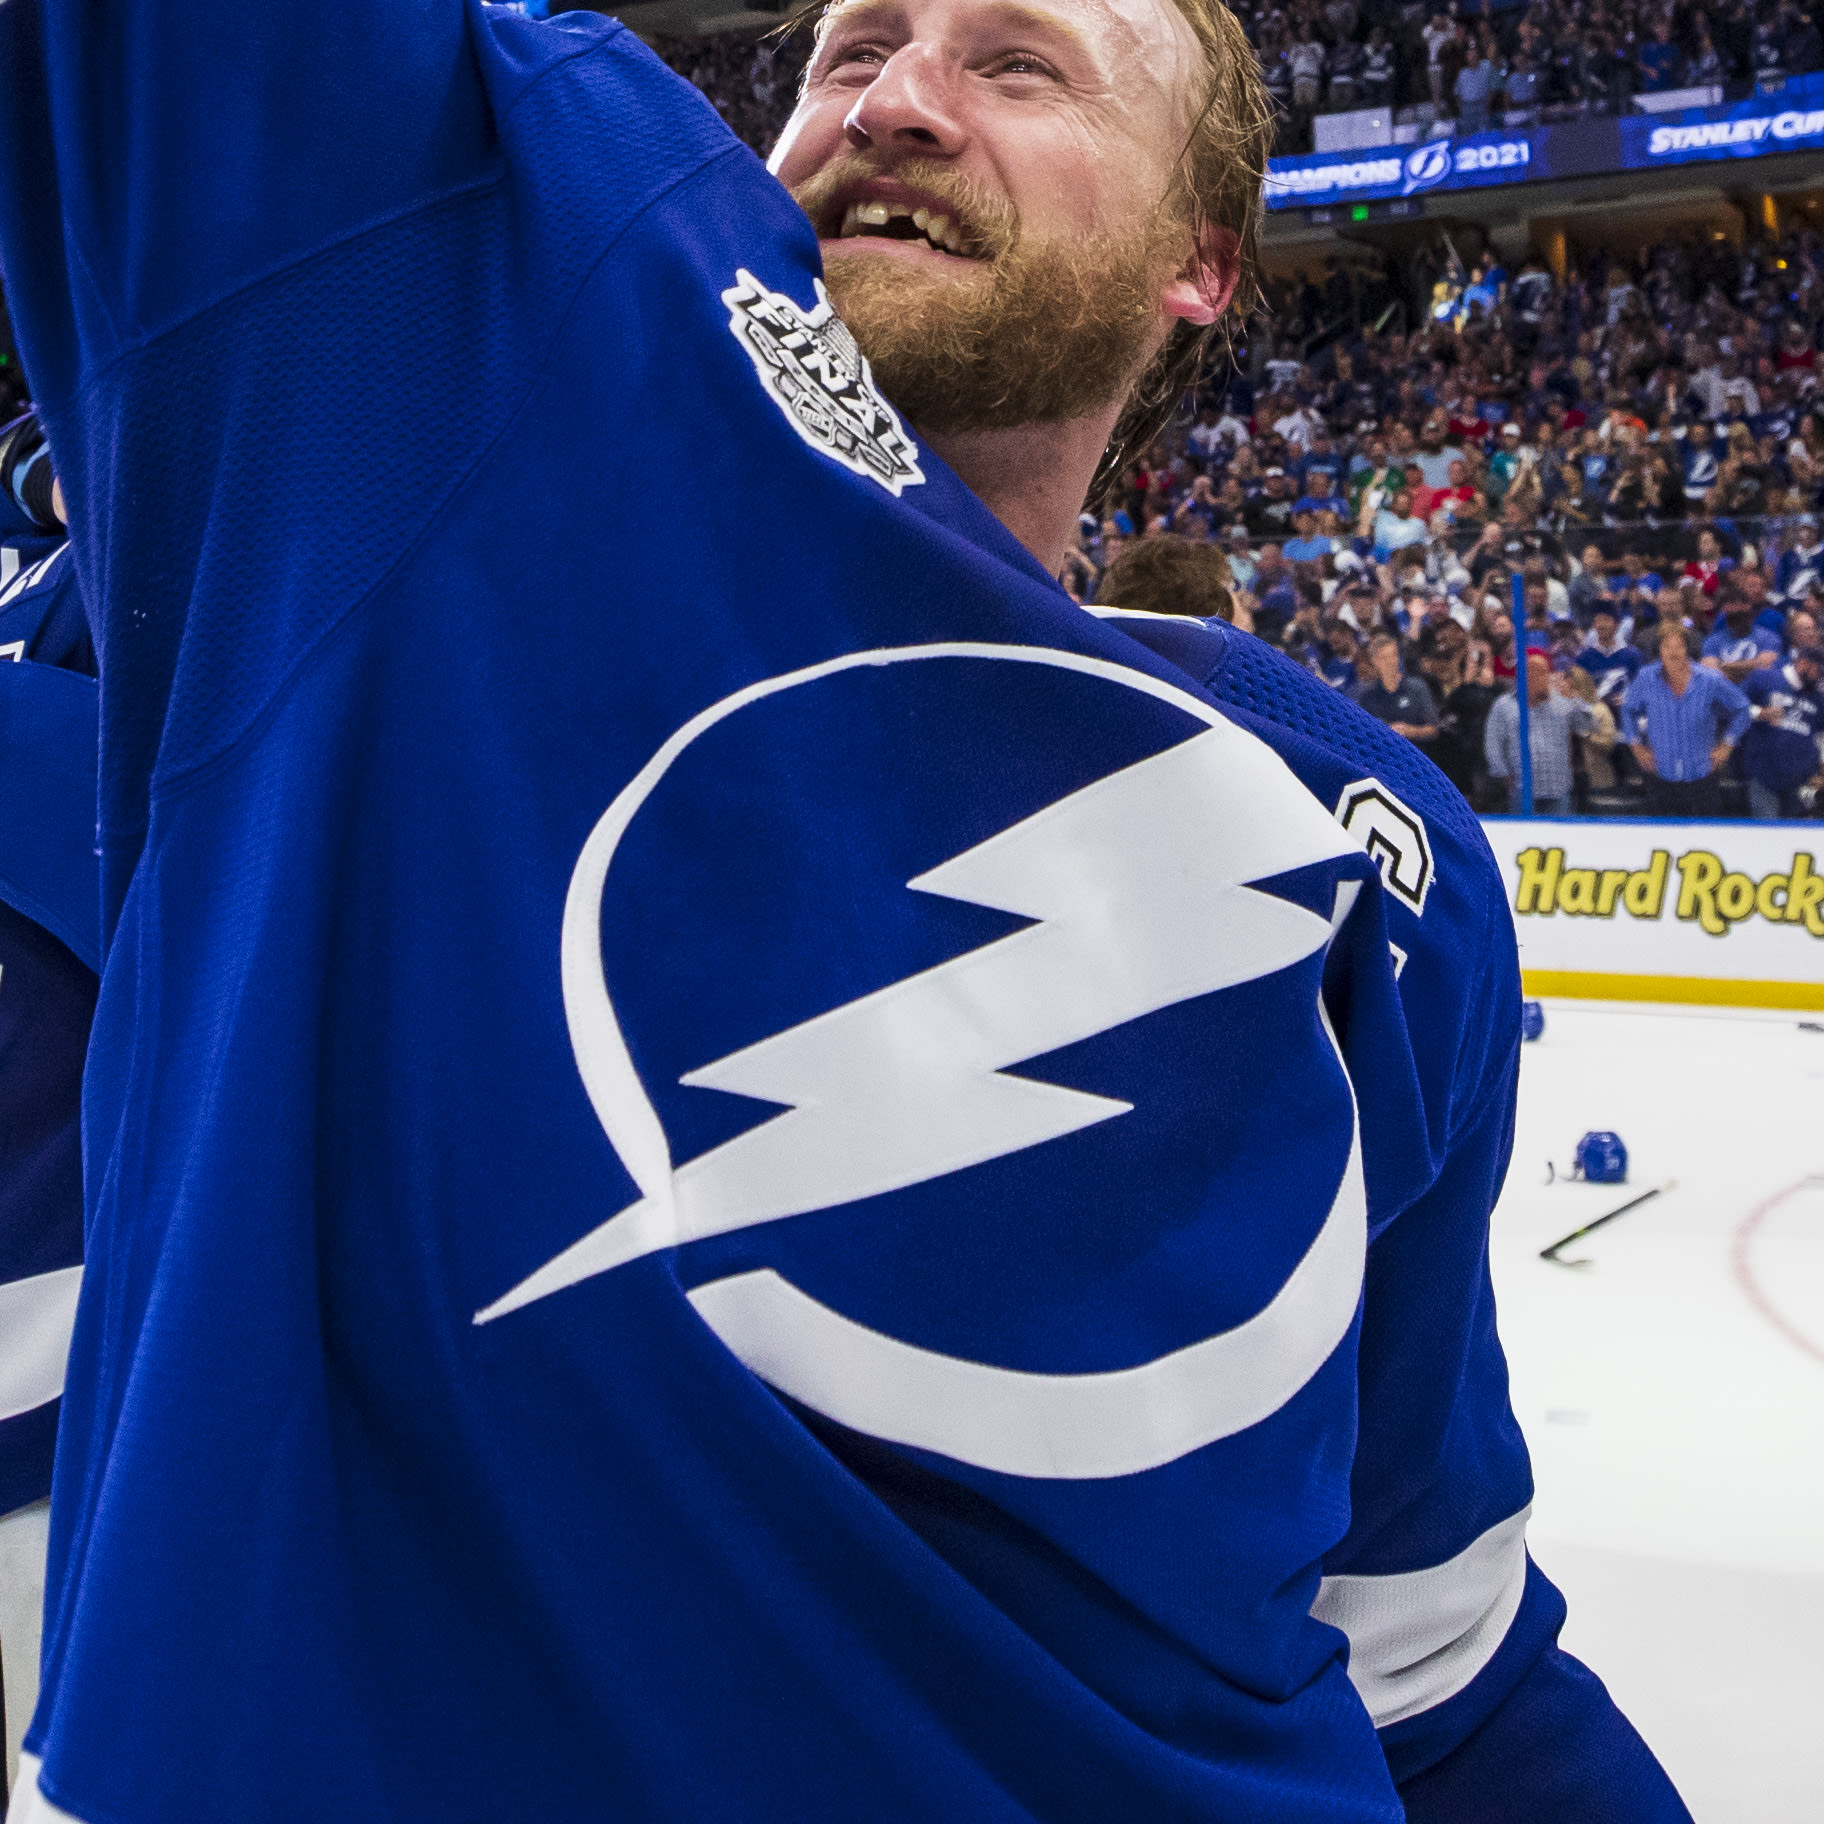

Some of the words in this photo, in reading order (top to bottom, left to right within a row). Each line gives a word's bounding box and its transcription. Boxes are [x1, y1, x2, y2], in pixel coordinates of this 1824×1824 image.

[1454, 140, 1530, 172] 2021
[1647, 116, 1773, 154] STANLEY
[777, 305, 857, 383] STANLEY
[744, 298, 906, 468] FINAL
[1515, 847, 1670, 919] Hard
